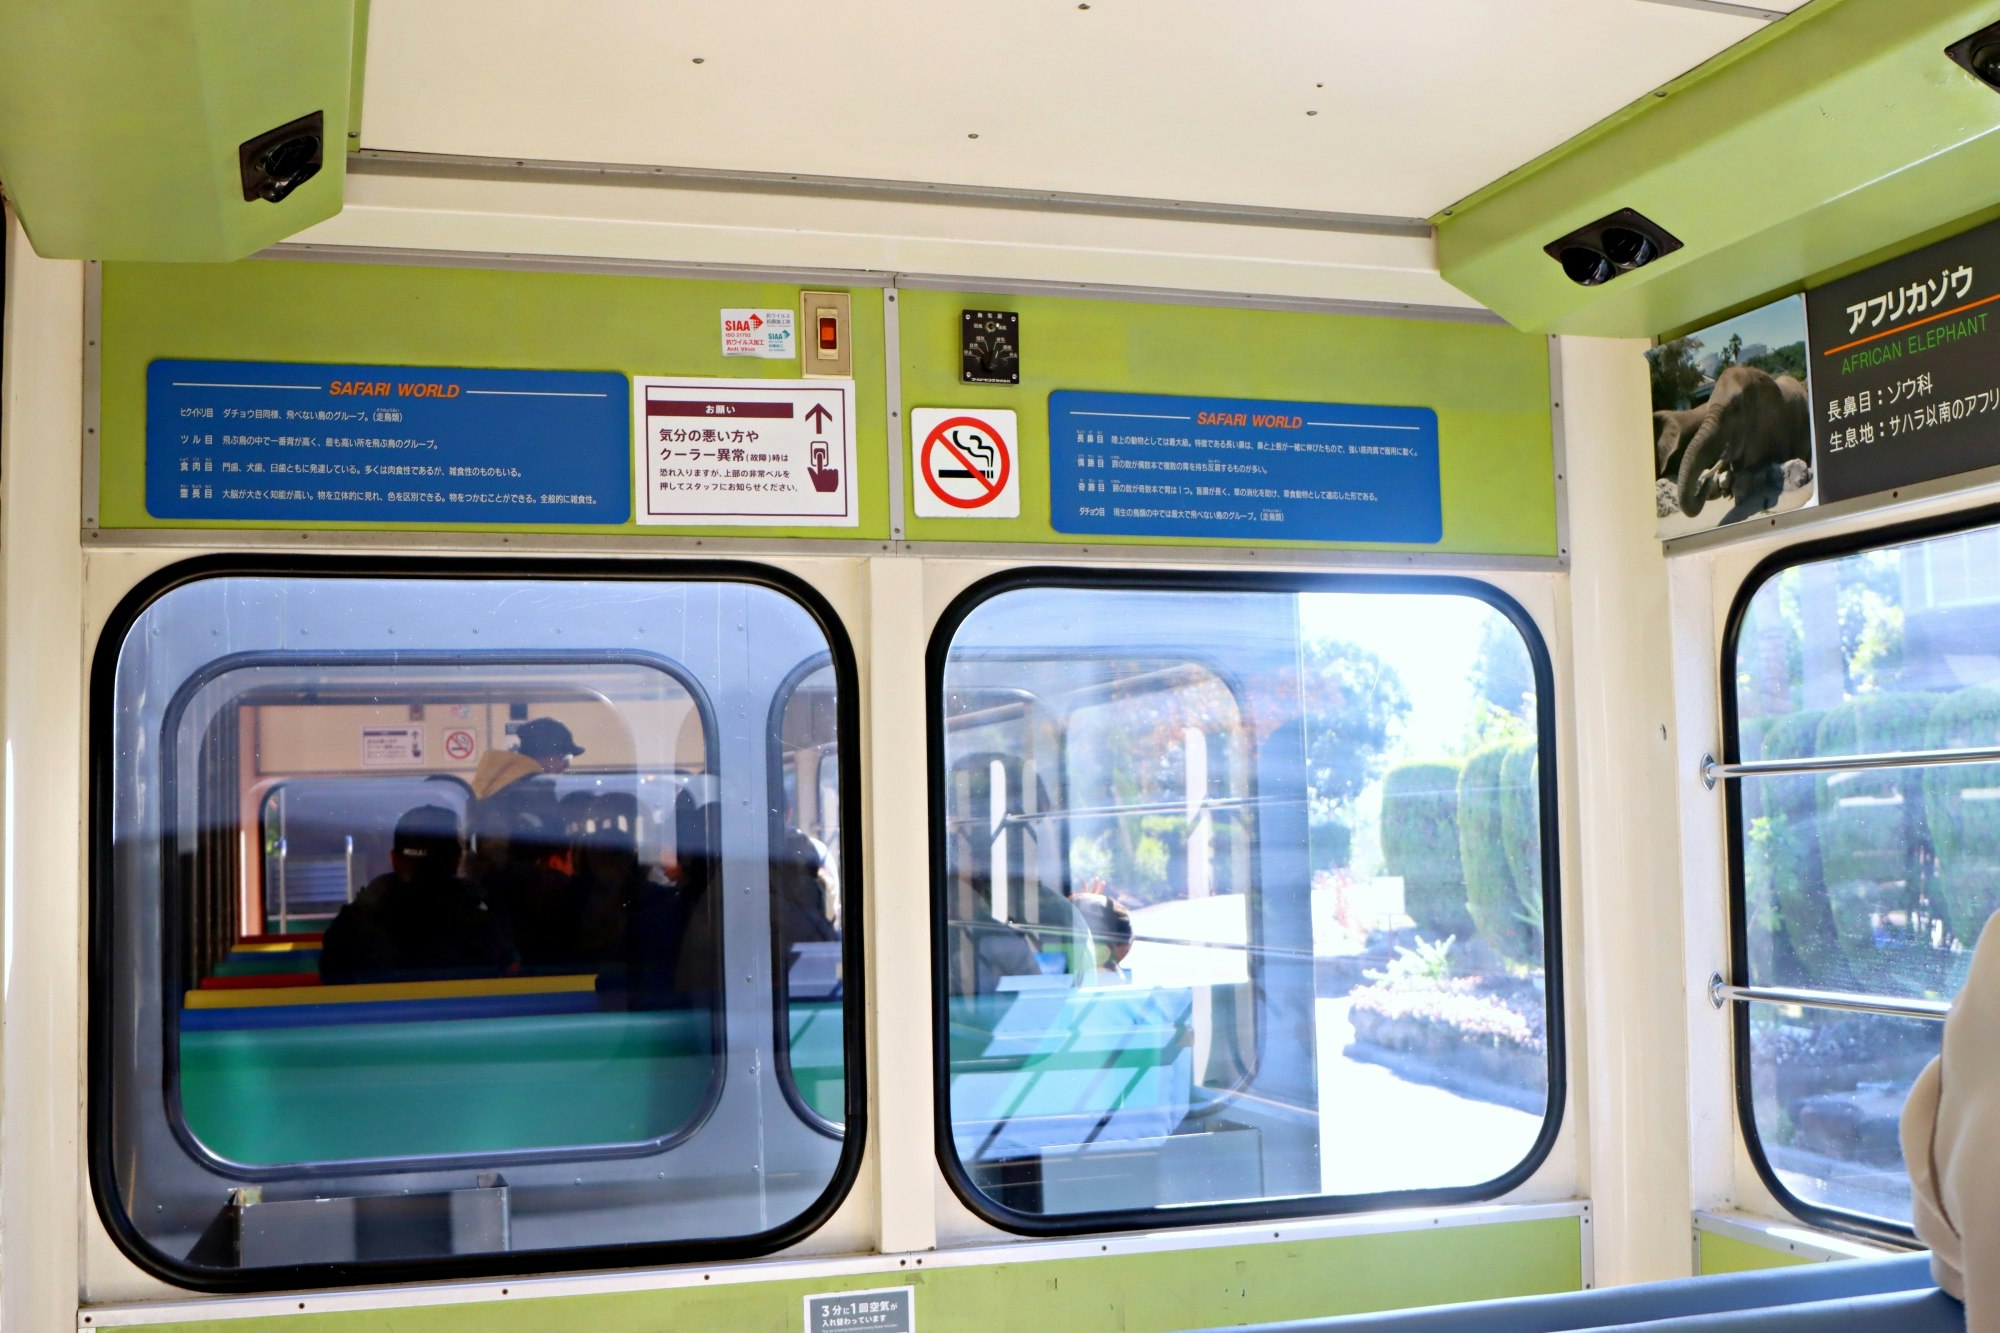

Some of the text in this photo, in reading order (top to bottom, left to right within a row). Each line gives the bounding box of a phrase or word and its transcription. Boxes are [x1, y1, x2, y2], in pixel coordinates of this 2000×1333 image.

[1846, 265, 1973, 335] アフリカゾウ
[725, 320, 750, 331] SIAA
[1842, 312, 1989, 375] AFRICAN ELEPHANT
[328, 380, 460, 399] SAFARI WORLD
[180, 407, 214, 418] ヒクイドリ目
[705, 404, 736, 415] お願い
[1197, 411, 1303, 429] SAFARI WORLD
[181, 434, 213, 445] ツル目
[659, 428, 759, 443] 気分の悪い方や
[180, 461, 213, 472] 食肉目
[659, 468, 790, 479] 恐れ入りますが、上部の非常ベルを
[660, 482, 798, 493] 押してスタッフにお知らせください。
[821, 1300, 898, 1317] 3分に1回空気が
[822, 1314, 886, 1328] 入れ替わっています
